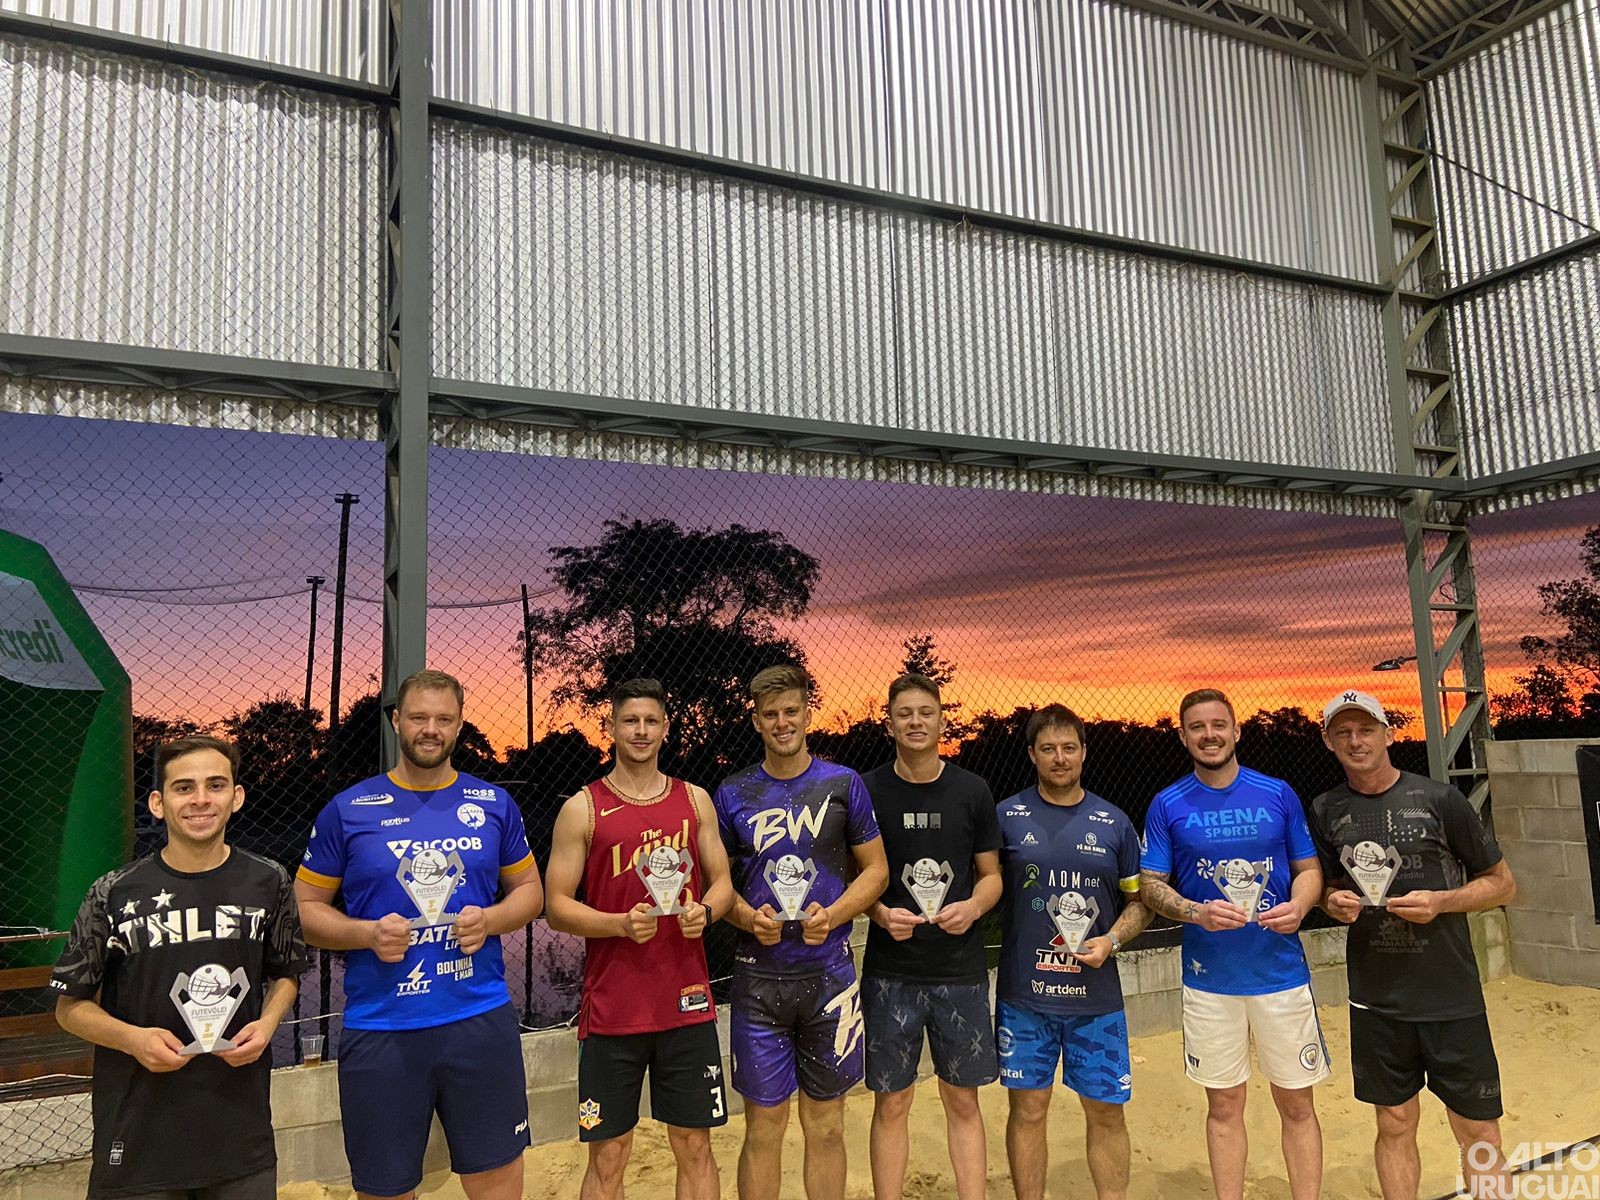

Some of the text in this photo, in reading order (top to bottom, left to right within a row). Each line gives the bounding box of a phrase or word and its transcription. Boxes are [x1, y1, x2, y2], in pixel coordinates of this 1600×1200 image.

[463, 788, 495, 796] HOSS
[747, 790, 834, 857] BW
[1088, 815, 1115, 825] Dray
[1184, 807, 1274, 829] ARENA
[640, 828, 662, 842] The
[1204, 825, 1258, 838] SPORTS
[412, 837, 483, 854] SICOOB
[1048, 869, 1100, 888] AOM net
[107, 905, 267, 955] THLET
[436, 955, 473, 975] BOLINHA
[1037, 963, 1081, 973] ESPORTES
[397, 979, 432, 992] TNT
[1045, 984, 1087, 995] artdent
[396, 988, 431, 997] ESPORTES
[191, 1006, 227, 1017] FUTEVÔLEI
[710, 1086, 724, 1118] 3
